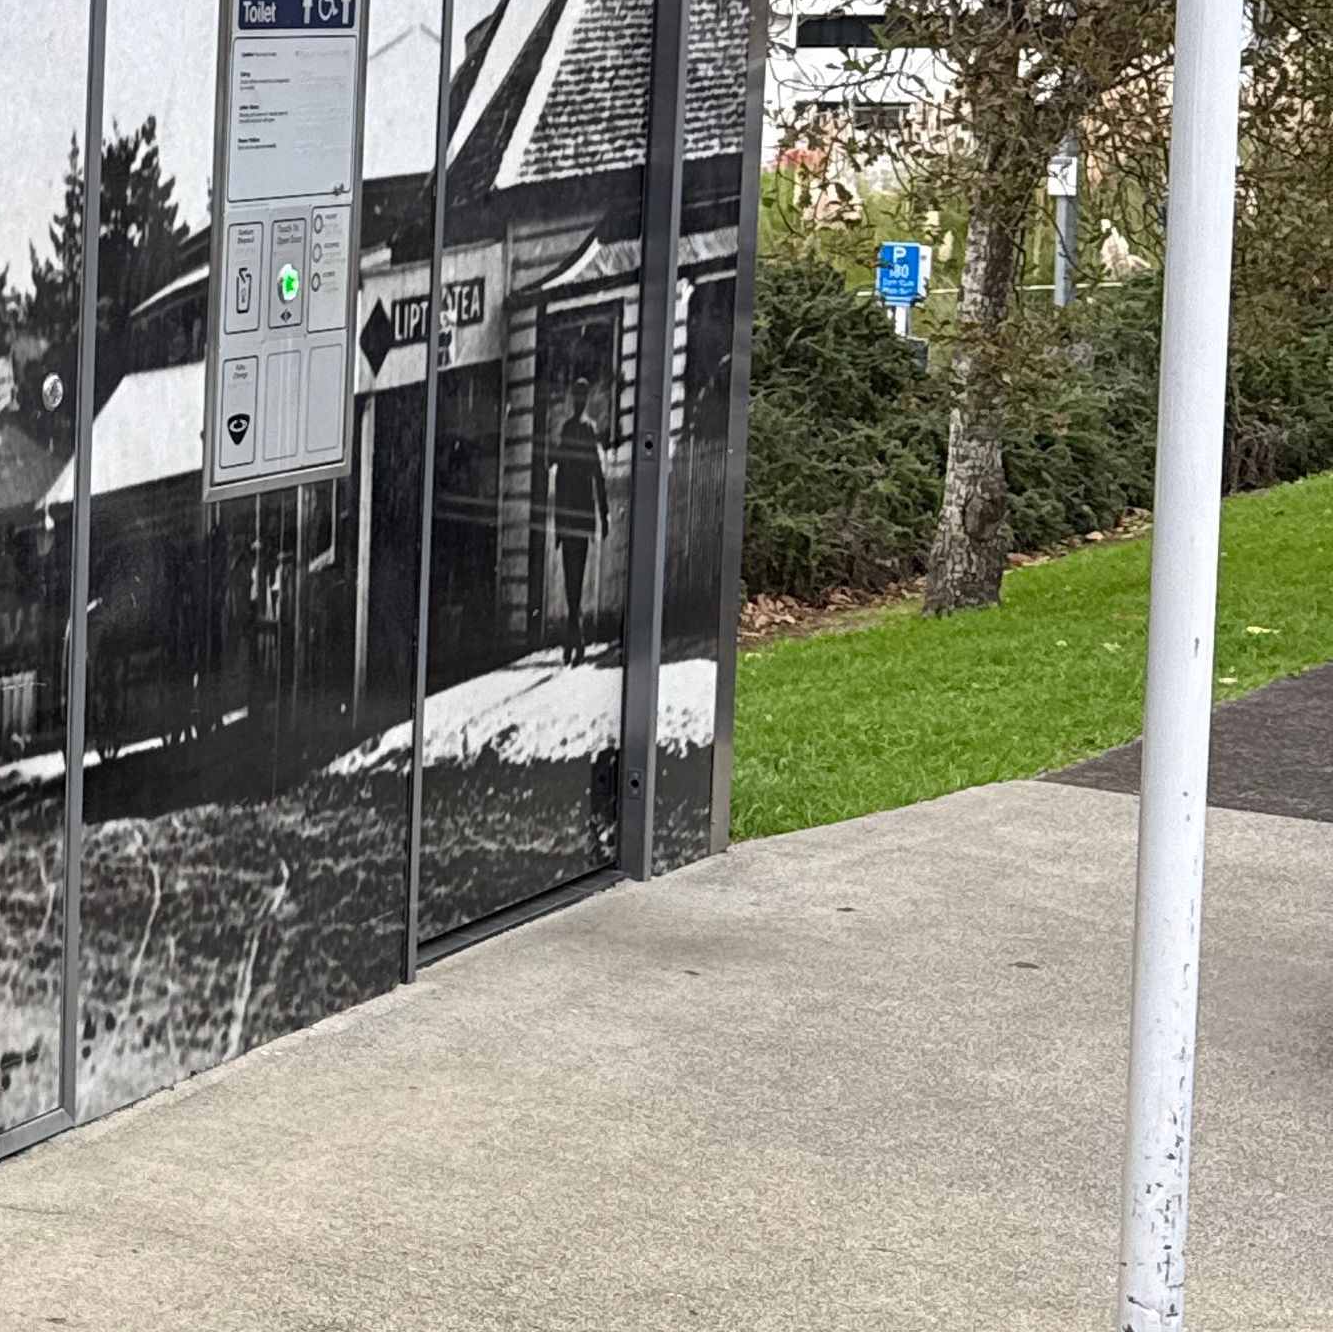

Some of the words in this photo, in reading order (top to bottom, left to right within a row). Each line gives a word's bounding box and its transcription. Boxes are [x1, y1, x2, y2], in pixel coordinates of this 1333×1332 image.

[243, 1, 276, 23] Toilet
[893, 246, 907, 264] P
[452, 284, 481, 321] TEA
